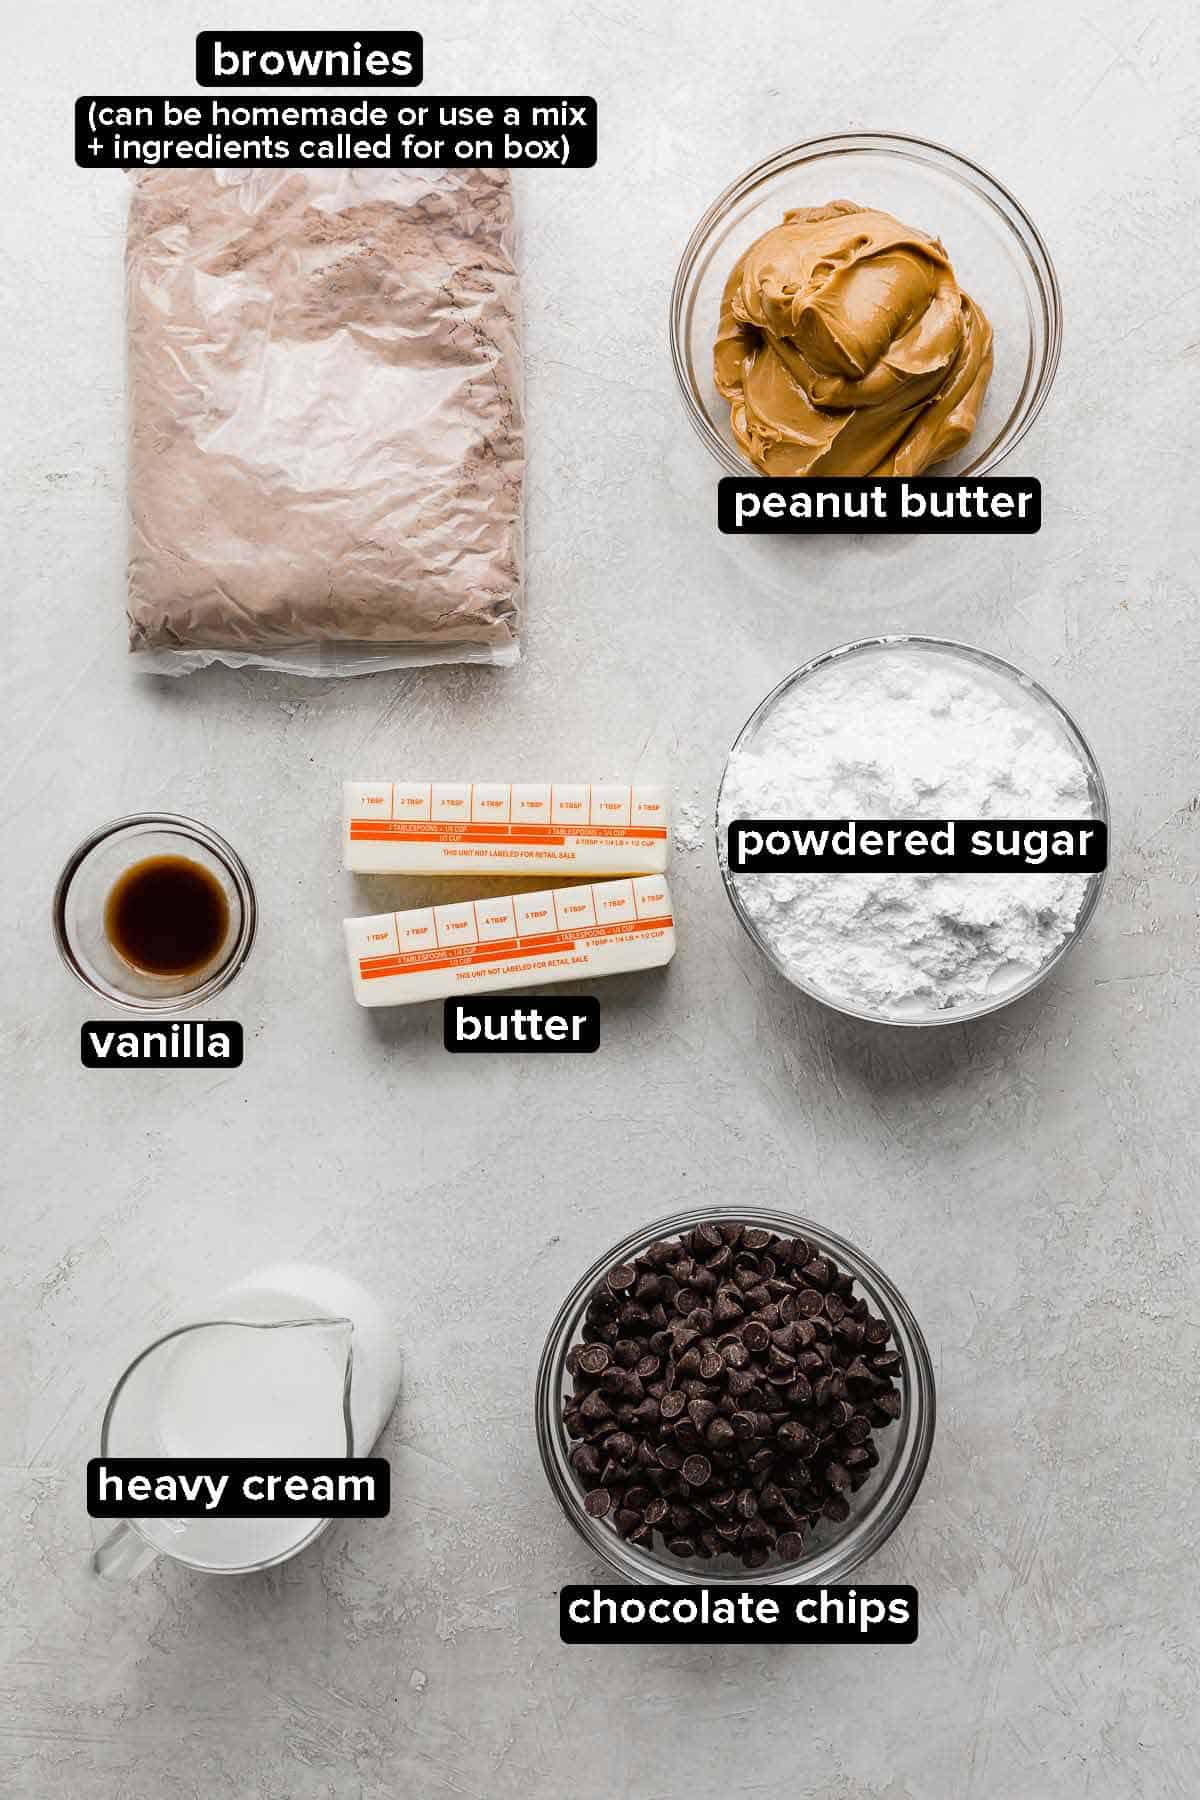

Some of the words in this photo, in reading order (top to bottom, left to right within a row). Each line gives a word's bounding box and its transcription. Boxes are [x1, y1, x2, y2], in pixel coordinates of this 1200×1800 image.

[489, 850, 519, 858] LABELED
[535, 851, 558, 859] RETAIL
[472, 969, 486, 978] UNIT
[488, 967, 501, 975] NOT
[503, 963, 531, 974] LABELED
[533, 960, 546, 969] FOR
[548, 958, 570, 967] RETAIL
[572, 955, 588, 963] SALE
